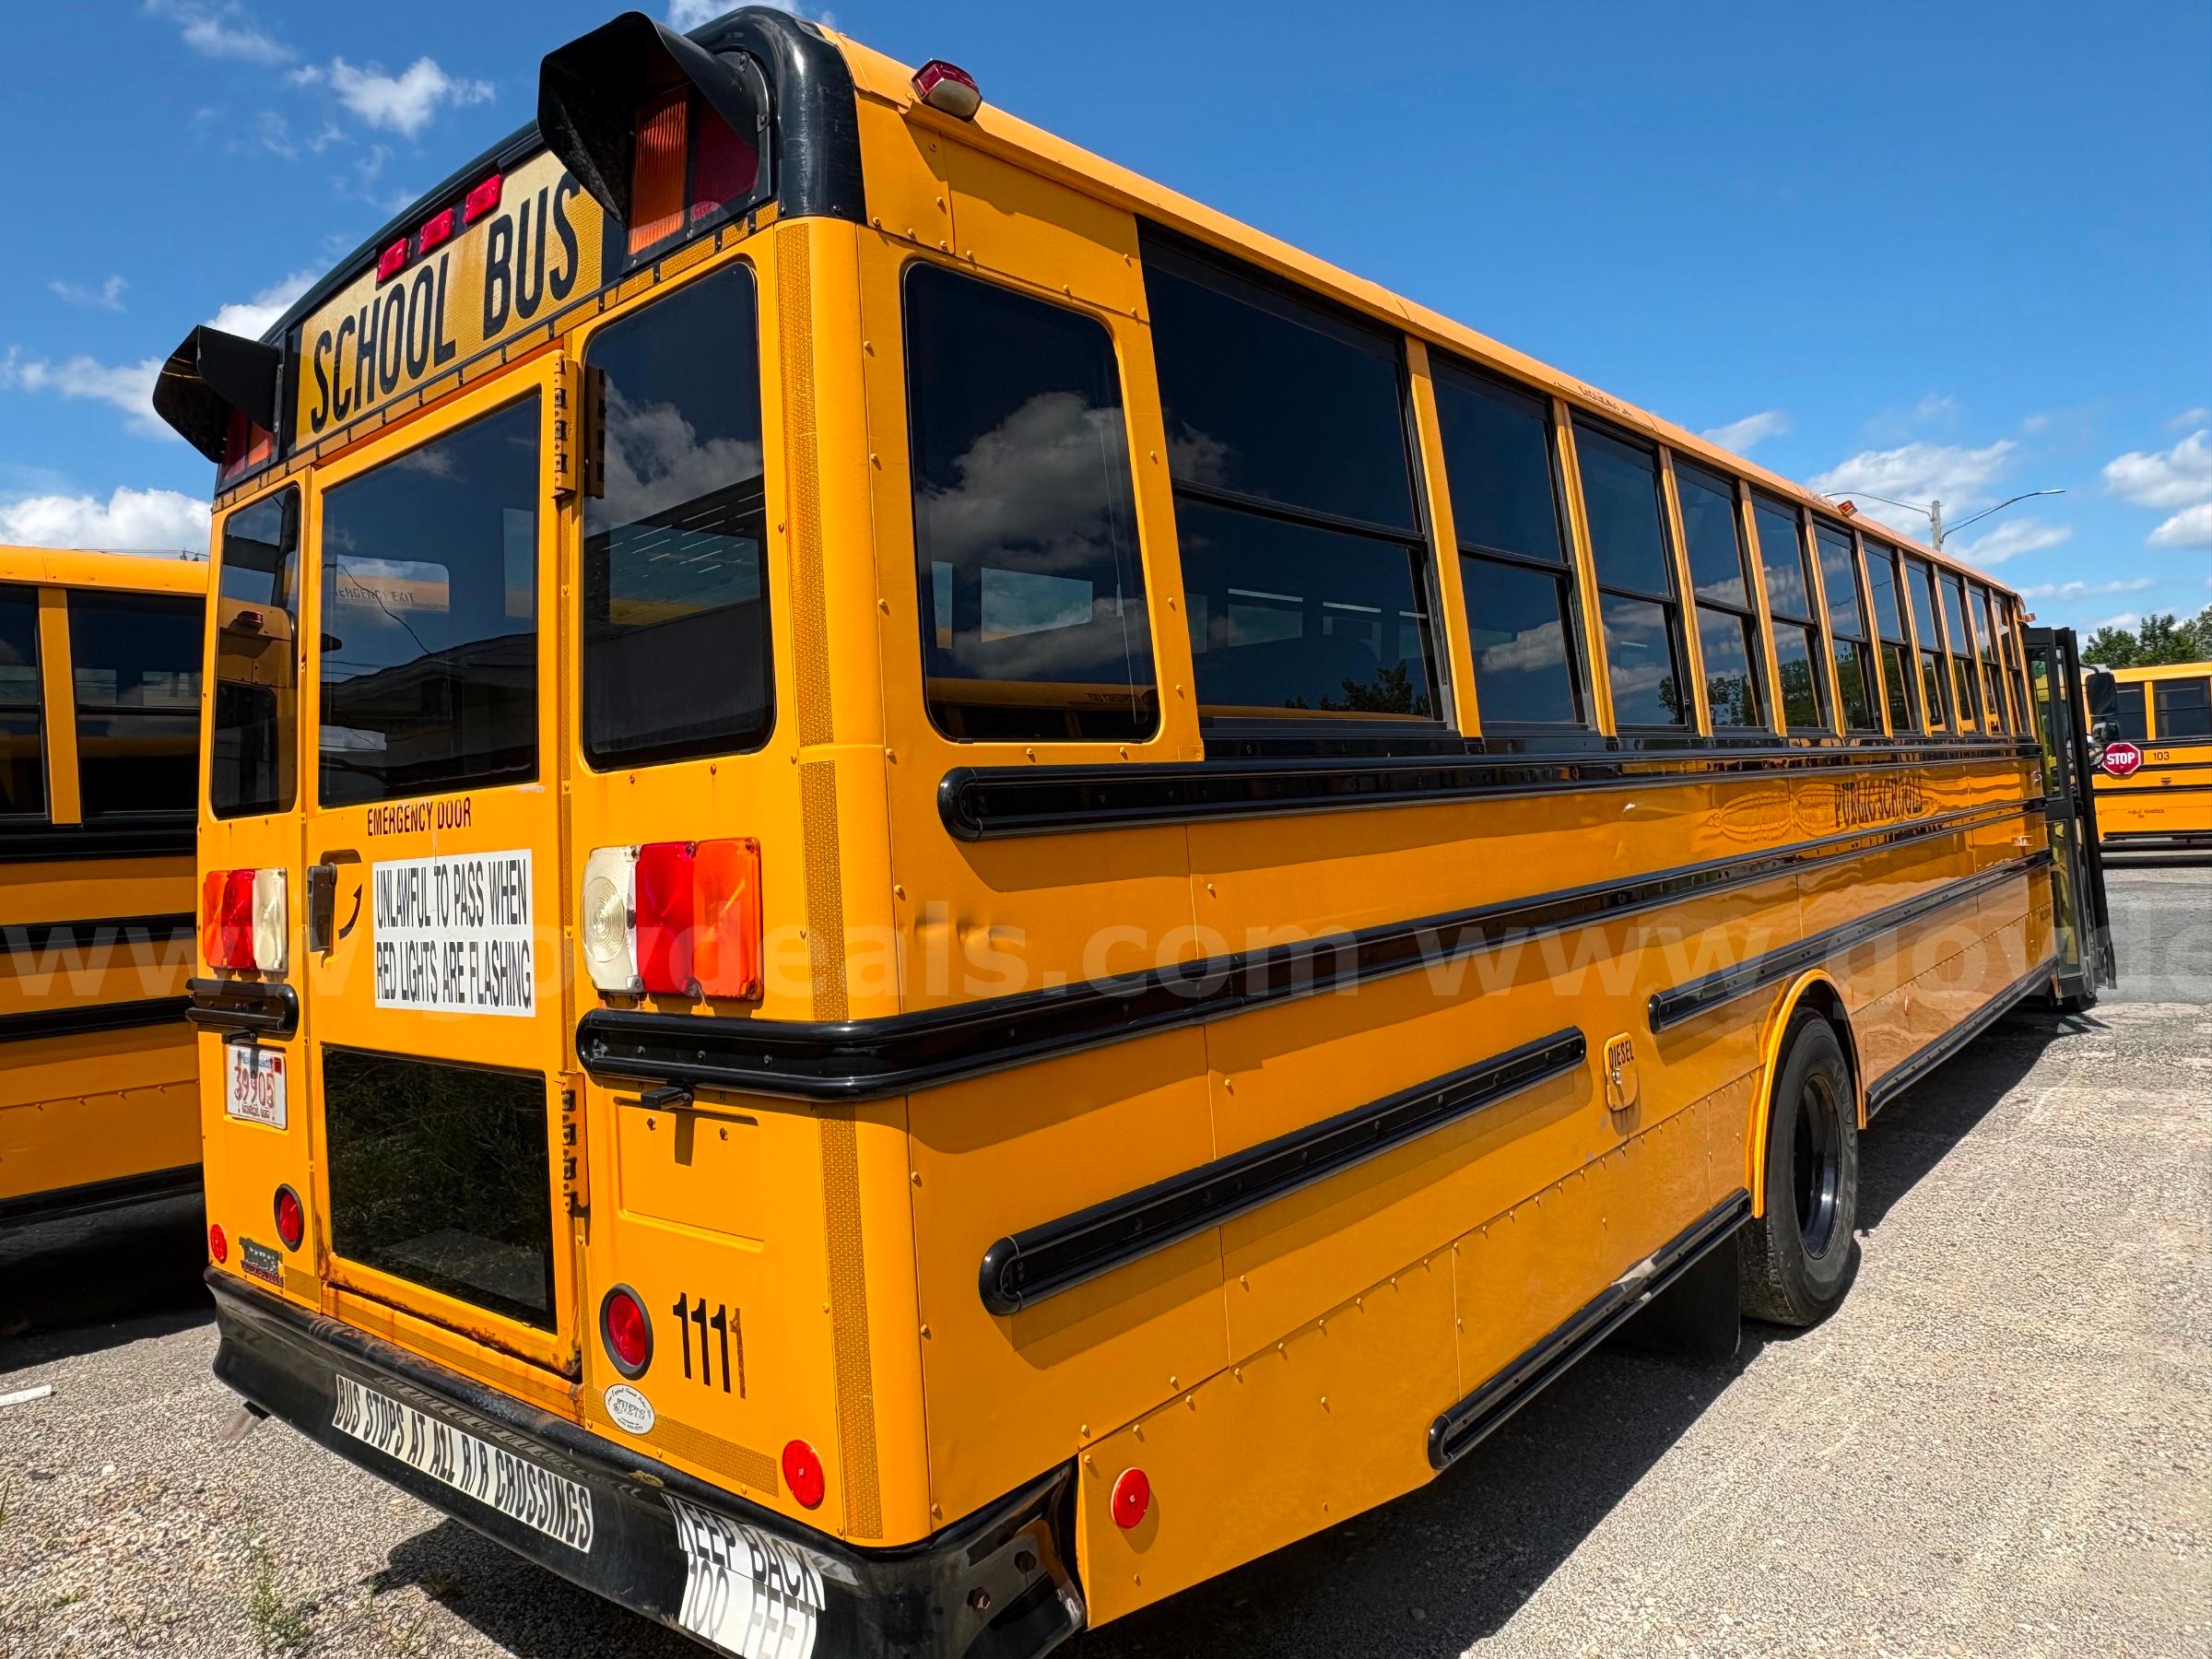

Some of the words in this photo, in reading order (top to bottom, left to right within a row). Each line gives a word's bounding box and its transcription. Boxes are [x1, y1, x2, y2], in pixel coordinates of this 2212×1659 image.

[311, 252, 456, 434] SCHOOL
[482, 171, 581, 341] BUS
[2106, 751, 2136, 765] STOP
[2153, 751, 2171, 761] 103
[367, 801, 434, 837] EMERGENCY
[437, 796, 472, 830] DOOR
[376, 866, 431, 929] UNLAWFUL
[433, 863, 450, 928] TO
[453, 860, 484, 928] PASS
[488, 858, 528, 925] WHEN
[376, 941, 396, 1000] RED
[399, 939, 439, 1004] LIGHTS
[442, 941, 465, 1004] ARE
[469, 939, 532, 1009] FLASHING
[233, 1065, 275, 1109] 39905
[1608, 1039, 1635, 1069] DIESEL
[334, 1376, 360, 1434] BUS
[363, 1389, 406, 1457] STOPS
[406, 1410, 426, 1466] AT
[429, 1420, 455, 1484] ALL
[460, 1433, 490, 1500] R/R
[494, 1449, 592, 1550] CROSSINGS
[662, 1495, 736, 1570] KEEP
[738, 1524, 823, 1611] BACK
[683, 1553, 730, 1641] 100
[741, 1579, 816, 1659] FEET
